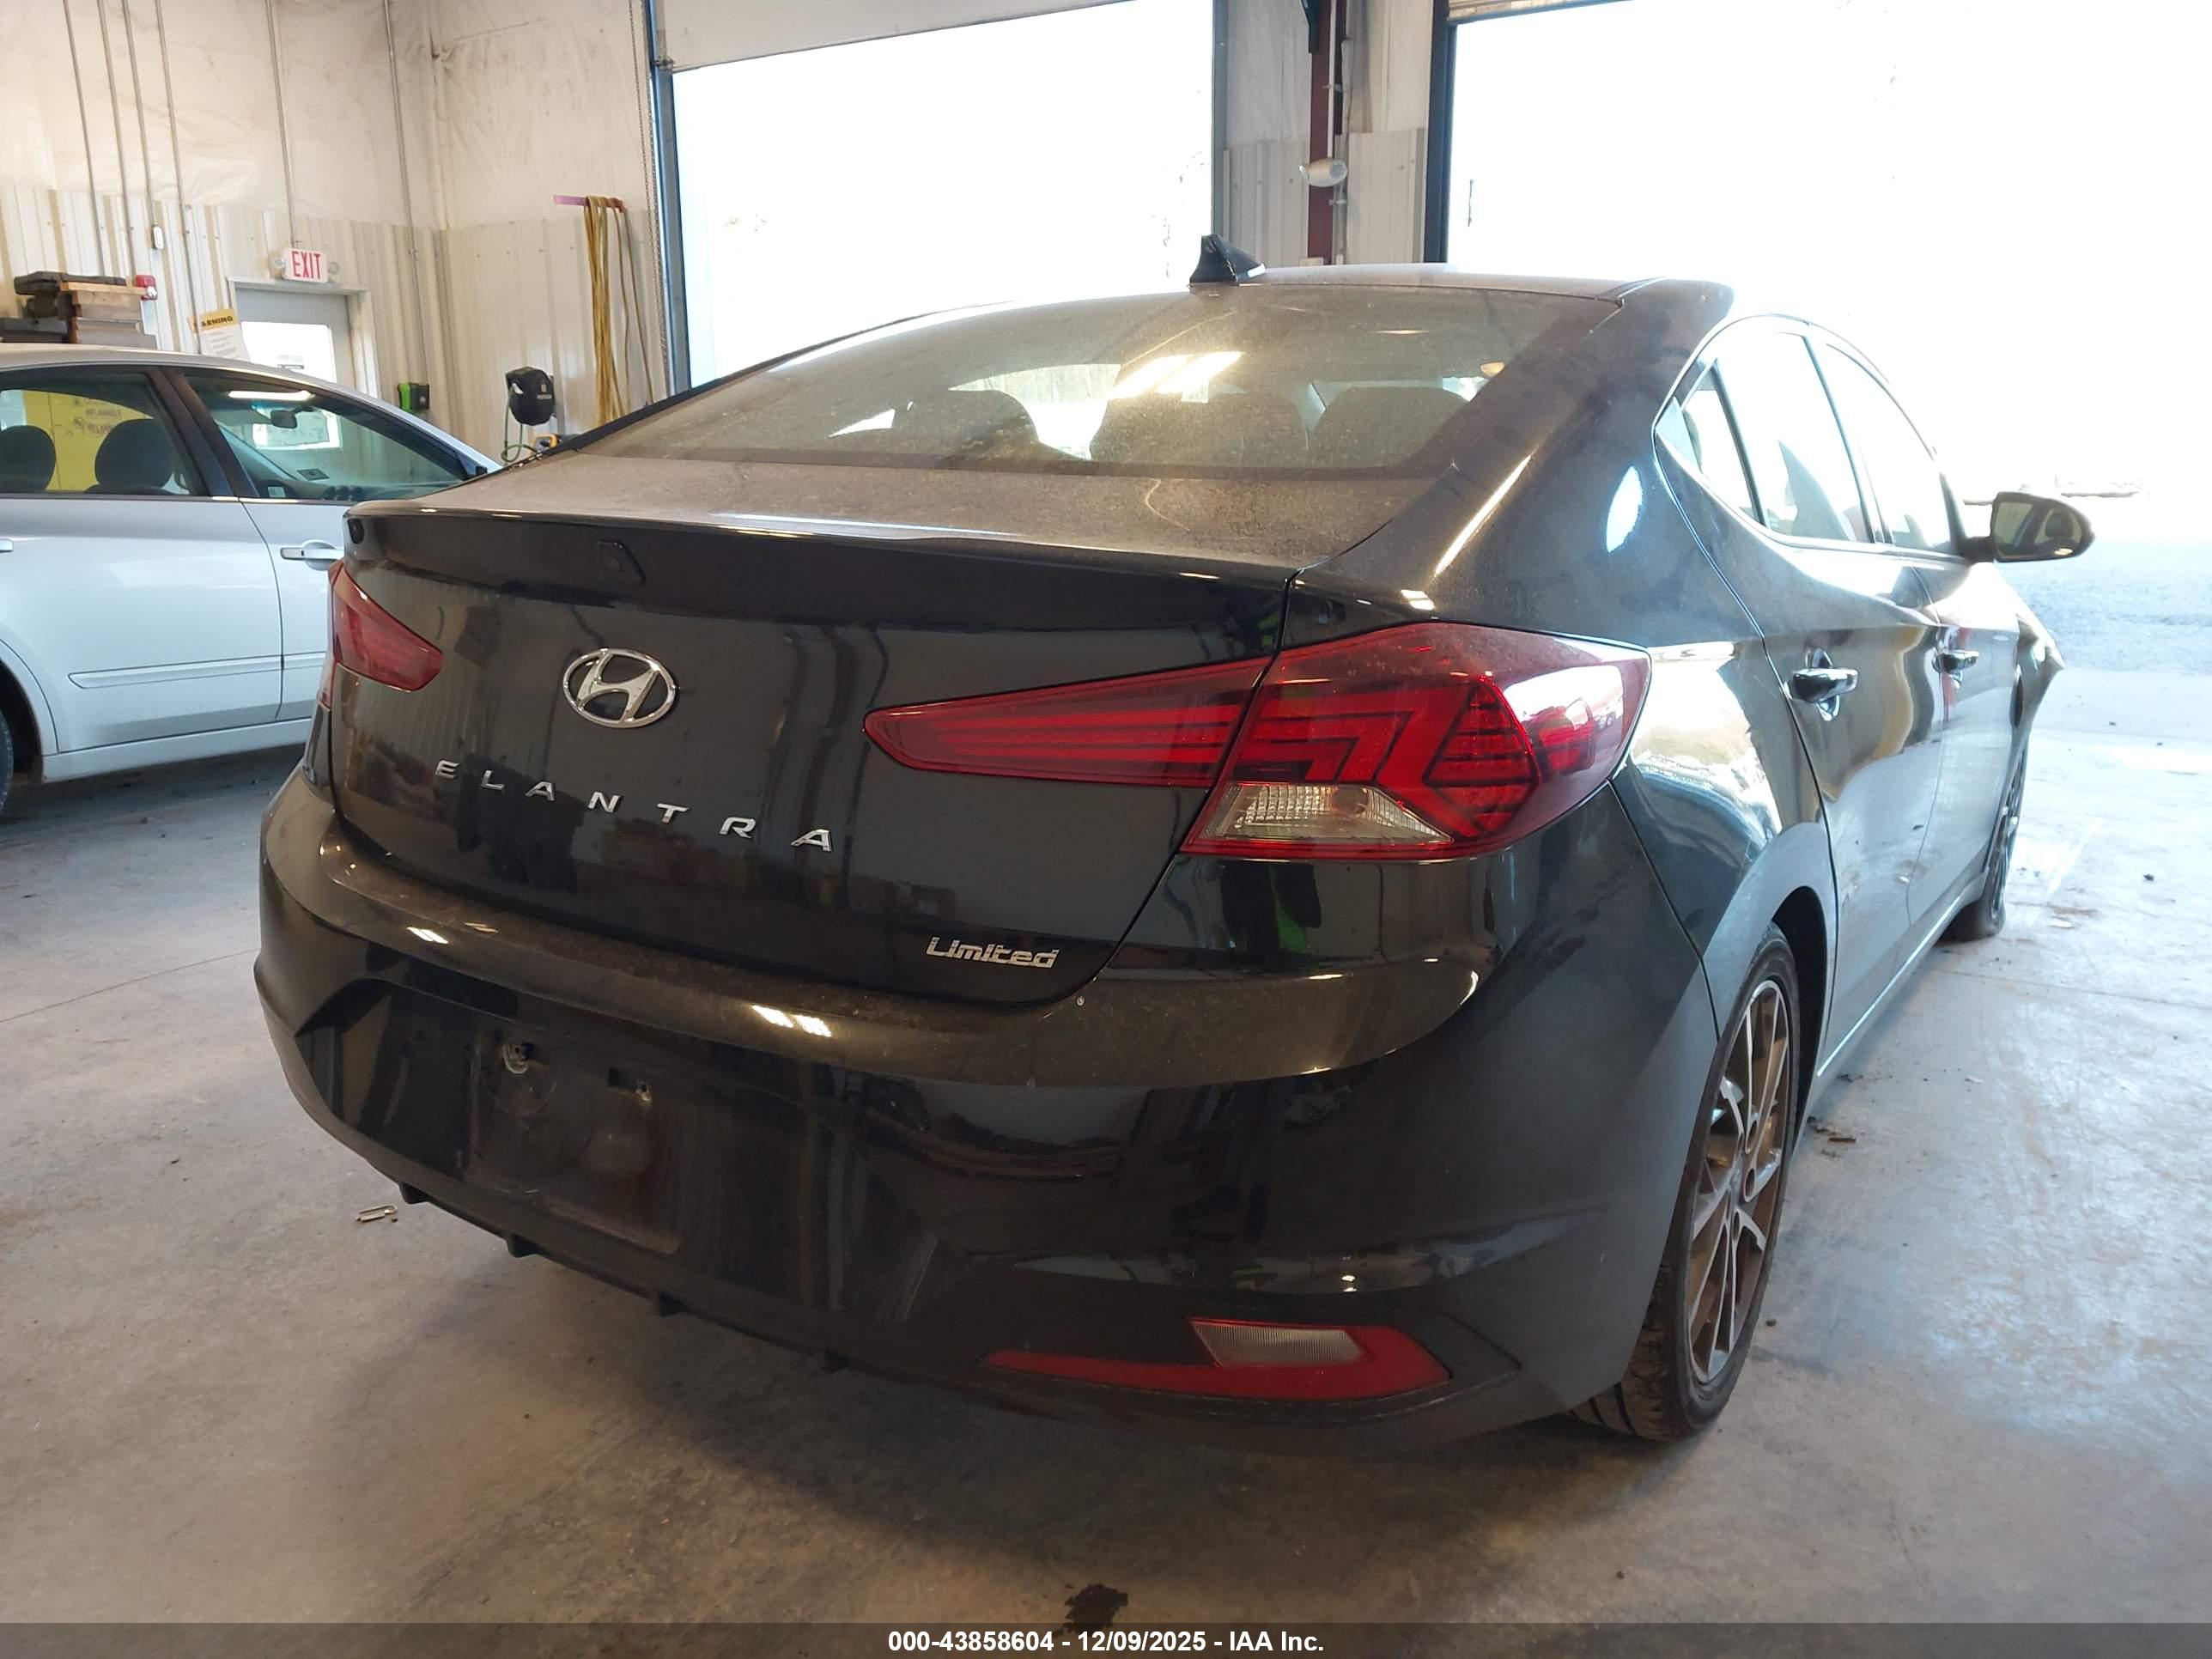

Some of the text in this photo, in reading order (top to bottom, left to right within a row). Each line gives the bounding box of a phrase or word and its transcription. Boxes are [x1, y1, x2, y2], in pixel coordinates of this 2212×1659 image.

[291, 250, 321, 280] EXIT
[434, 759, 833, 853] ELANTRA
[926, 936, 1060, 969] Limited
